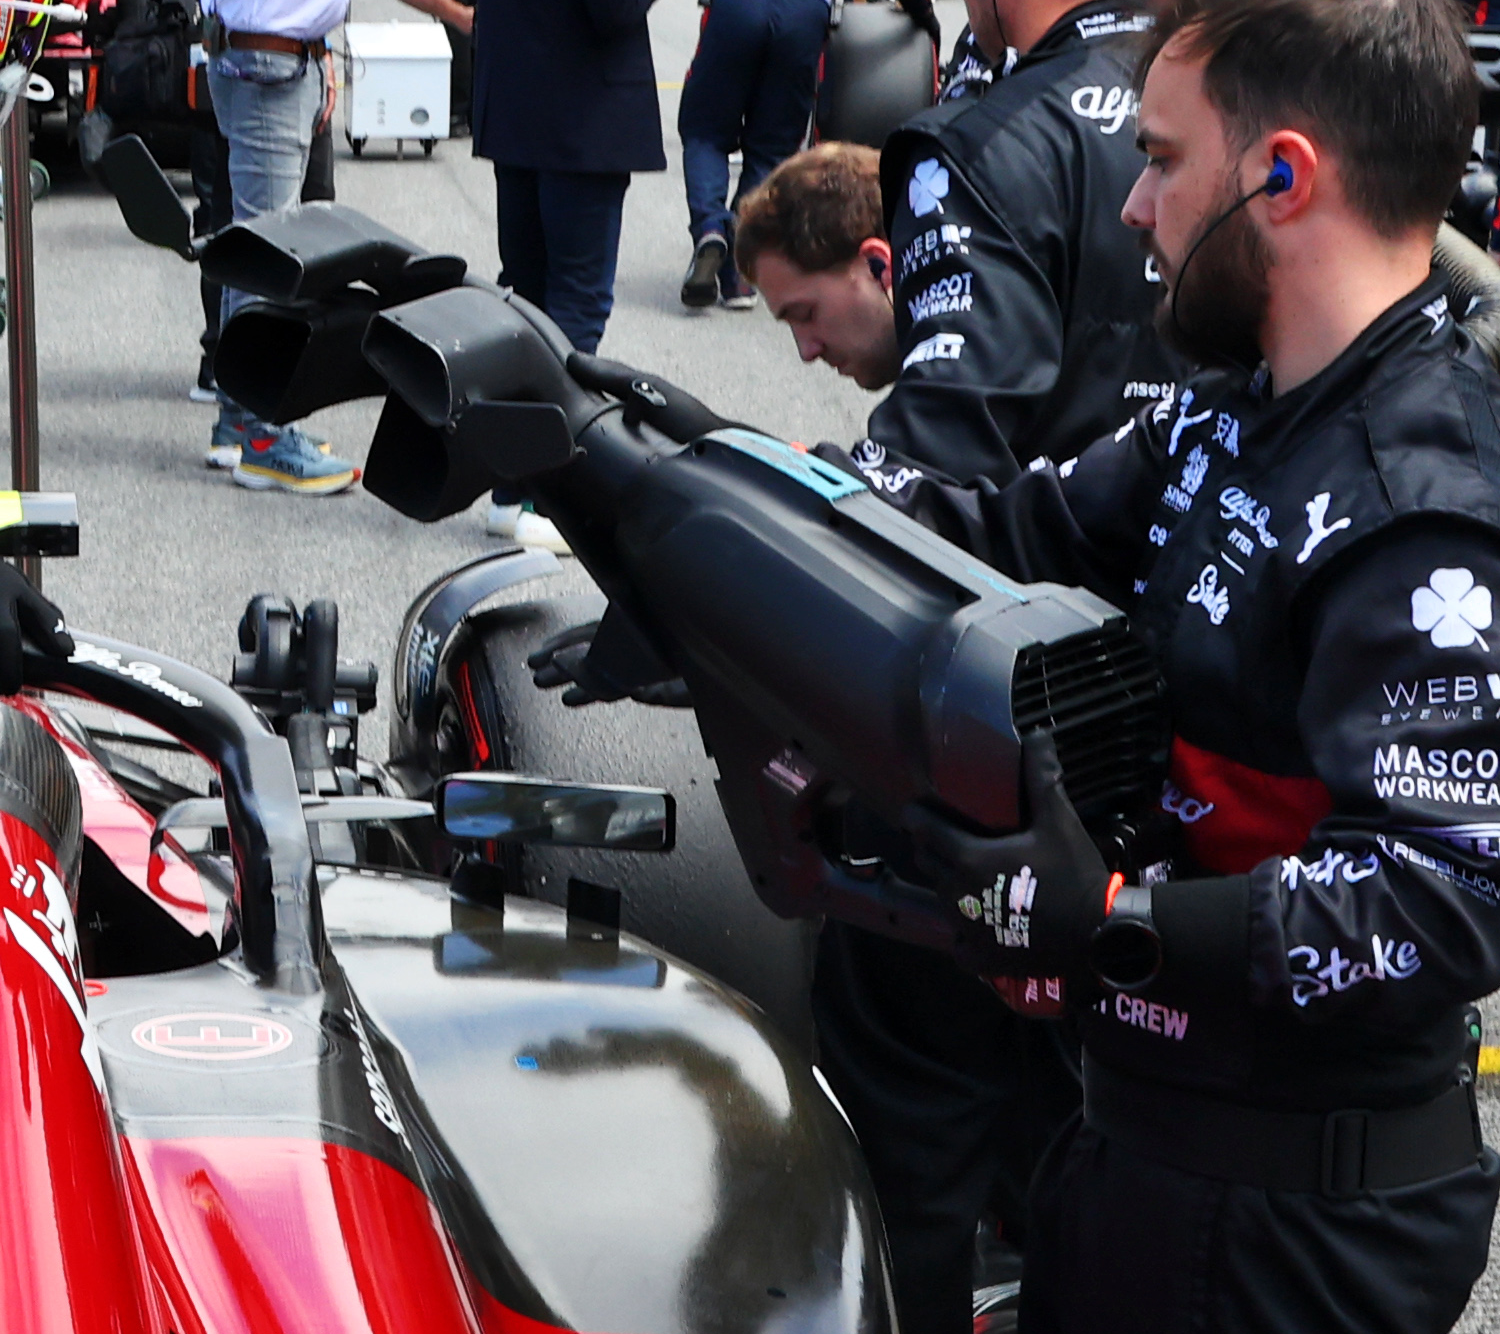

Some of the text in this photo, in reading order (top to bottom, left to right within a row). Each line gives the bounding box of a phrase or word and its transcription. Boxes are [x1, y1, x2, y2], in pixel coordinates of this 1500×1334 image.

[1070, 85, 1142, 135] Alf
[1382, 675, 1479, 708] WEB
[1288, 933, 1422, 1007] Stake
[1116, 993, 1189, 1041] CREW
